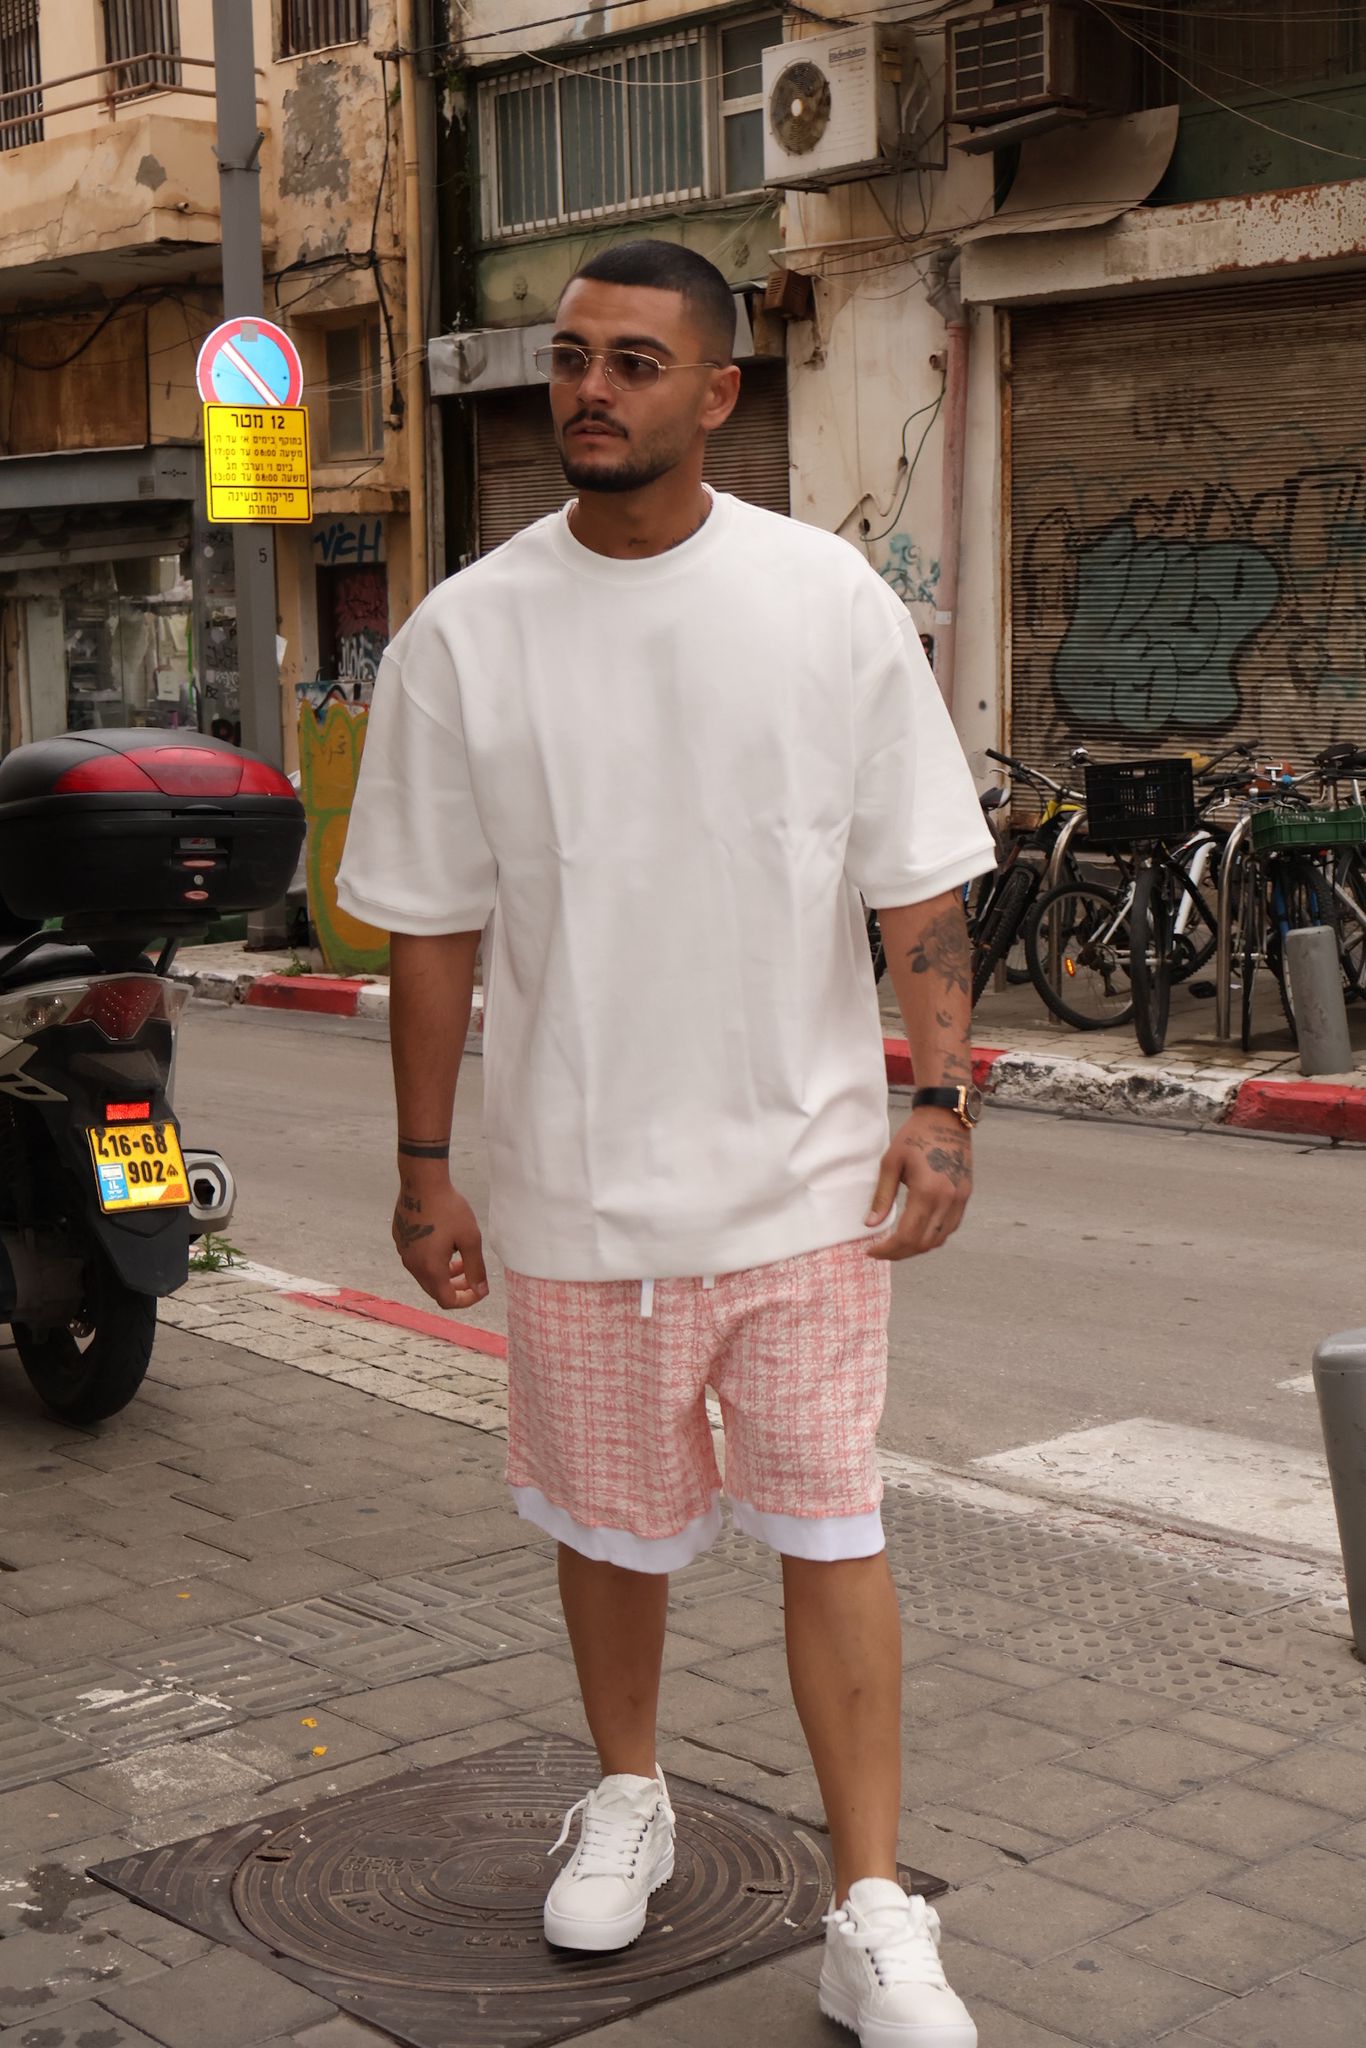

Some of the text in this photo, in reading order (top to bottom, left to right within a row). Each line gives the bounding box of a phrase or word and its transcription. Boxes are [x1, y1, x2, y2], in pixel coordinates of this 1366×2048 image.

[231, 413, 285, 430] 12 מטר
[227, 491, 295, 504] פריקה וטעינה
[248, 504, 277, 515] מותרת
[258, 547, 268, 564] 5
[127, 1159, 167, 1184] 902
[108, 1179, 120, 1190] IL
